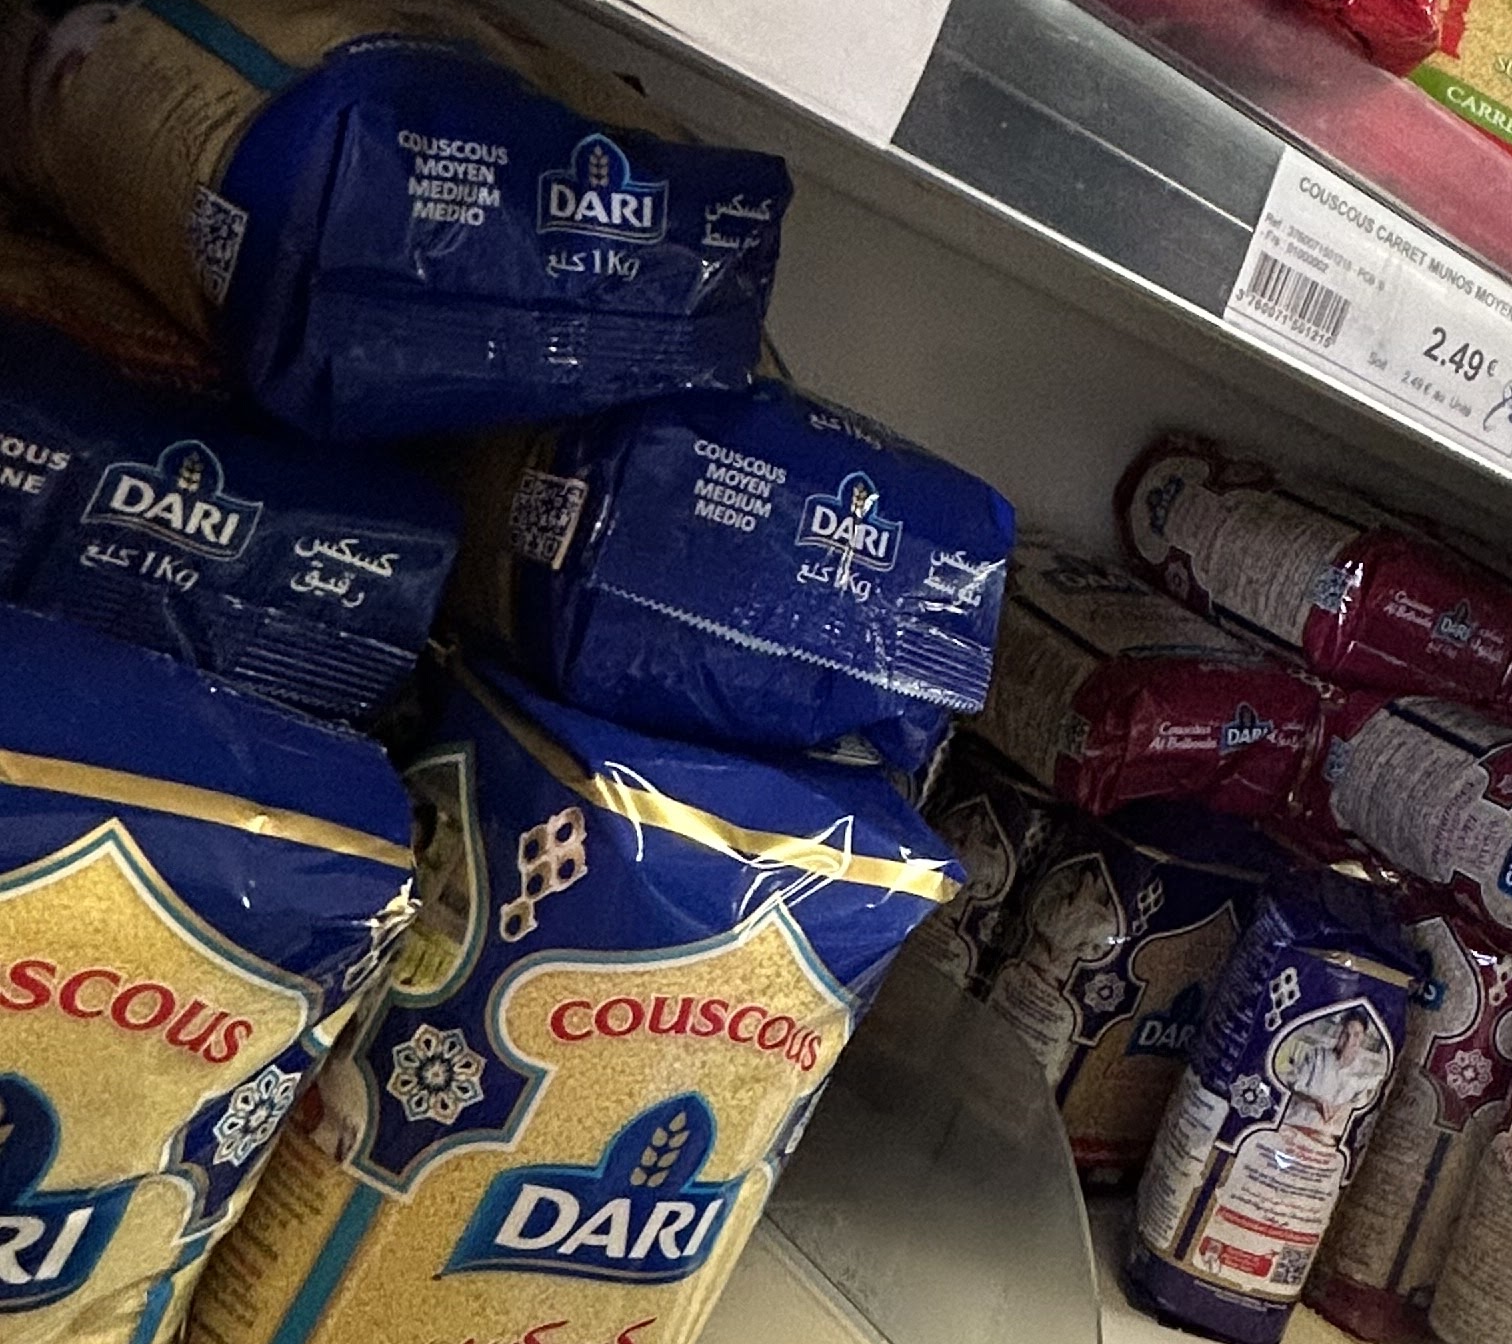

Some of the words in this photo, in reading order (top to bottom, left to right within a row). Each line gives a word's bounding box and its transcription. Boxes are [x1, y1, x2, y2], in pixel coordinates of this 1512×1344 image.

[397, 128, 509, 167] COUSCOUS
[413, 156, 496, 185] MOYEN
[407, 178, 502, 208] MEDIUM
[411, 199, 486, 227] MEDIO
[548, 182, 655, 229] DARI
[1299, 175, 1376, 235] COUSCOUS
[1375, 223, 1429, 268] CARRET
[1428, 256, 1475, 300] MUNOS
[1422, 325, 1484, 382] 2.49
[1486, 358, 1499, 378] €
[693, 438, 788, 485] COUSCOUS
[706, 462, 773, 499] MOYEN
[108, 473, 240, 547] DARI
[693, 478, 773, 519] MEDIUM
[693, 499, 757, 533] MEDIO
[810, 505, 891, 559] DARI
[294, 535, 401, 579] كسكس
[0, 957, 254, 1066] SCOUS
[548, 994, 824, 1074] COUSCOUS
[1138, 1019, 1196, 1049] DAR
[494, 1183, 725, 1260] DARI
[0, 1207, 94, 1284] RI
